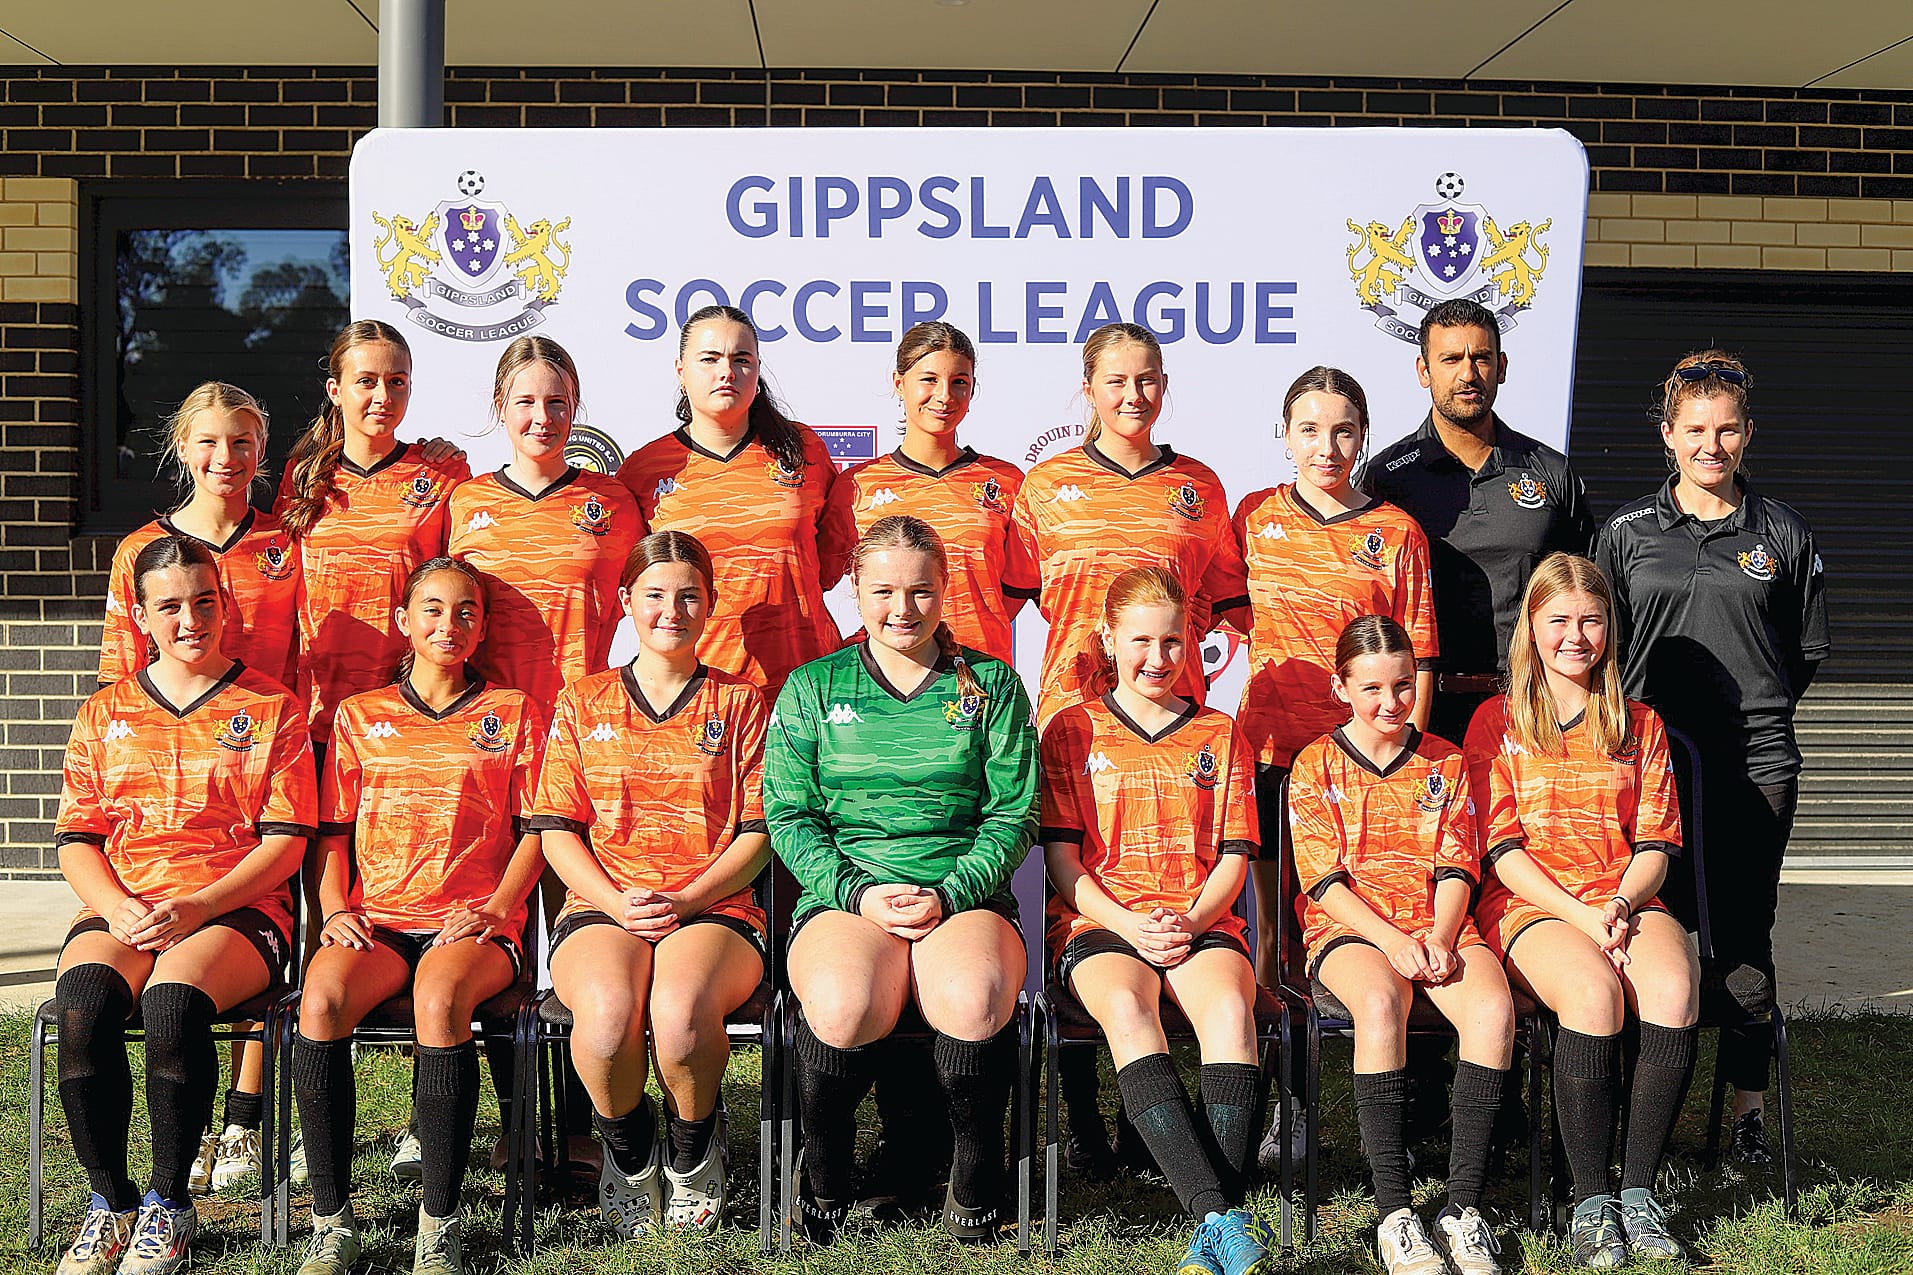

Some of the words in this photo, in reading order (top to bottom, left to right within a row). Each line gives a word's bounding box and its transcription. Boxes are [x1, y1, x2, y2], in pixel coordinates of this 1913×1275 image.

[725, 175, 1194, 239] GIPPSLAND
[435, 284, 516, 305] GIPPSLAND
[1407, 291, 1490, 309] GIPPND
[624, 278, 949, 343] SOCCER
[978, 281, 1298, 345] LEAGUE
[415, 312, 475, 339] SOCCER
[480, 314, 537, 340] LEAGUE
[1385, 320, 1421, 342] SOCC
[578, 435, 606, 452] UNITED
[1024, 425, 1072, 464] DROUIN
[795, 1195, 842, 1220] EVERLAST
[950, 1208, 997, 1227] EVERLAST
